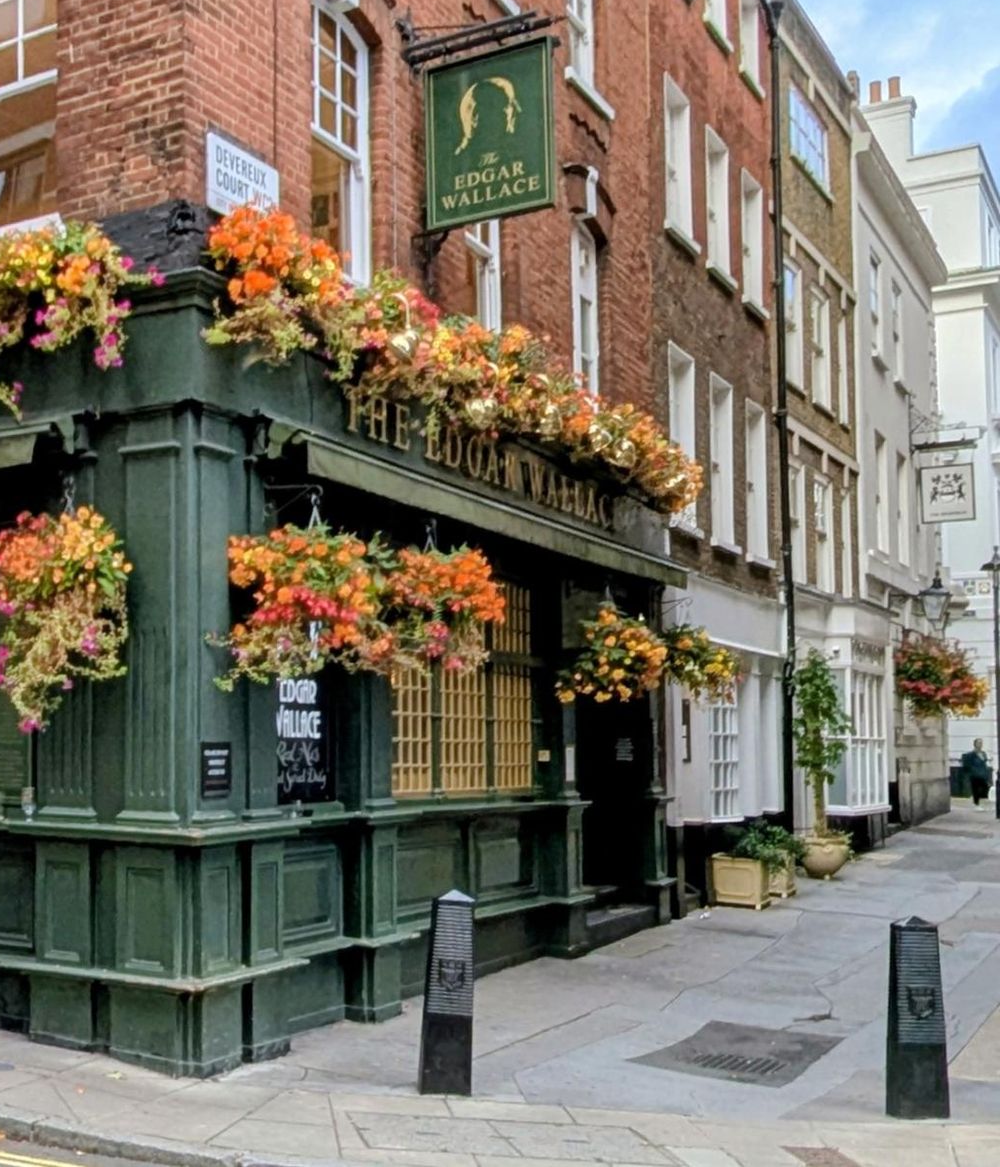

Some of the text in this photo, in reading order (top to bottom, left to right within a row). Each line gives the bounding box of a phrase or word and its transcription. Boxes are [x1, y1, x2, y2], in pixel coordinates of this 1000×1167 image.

[215, 145, 267, 190] DEVEREUX
[215, 167, 250, 204] COURT
[454, 161, 526, 192] EDGAR
[441, 175, 541, 211] WALLACE
[279, 678, 318, 705] EDGAR
